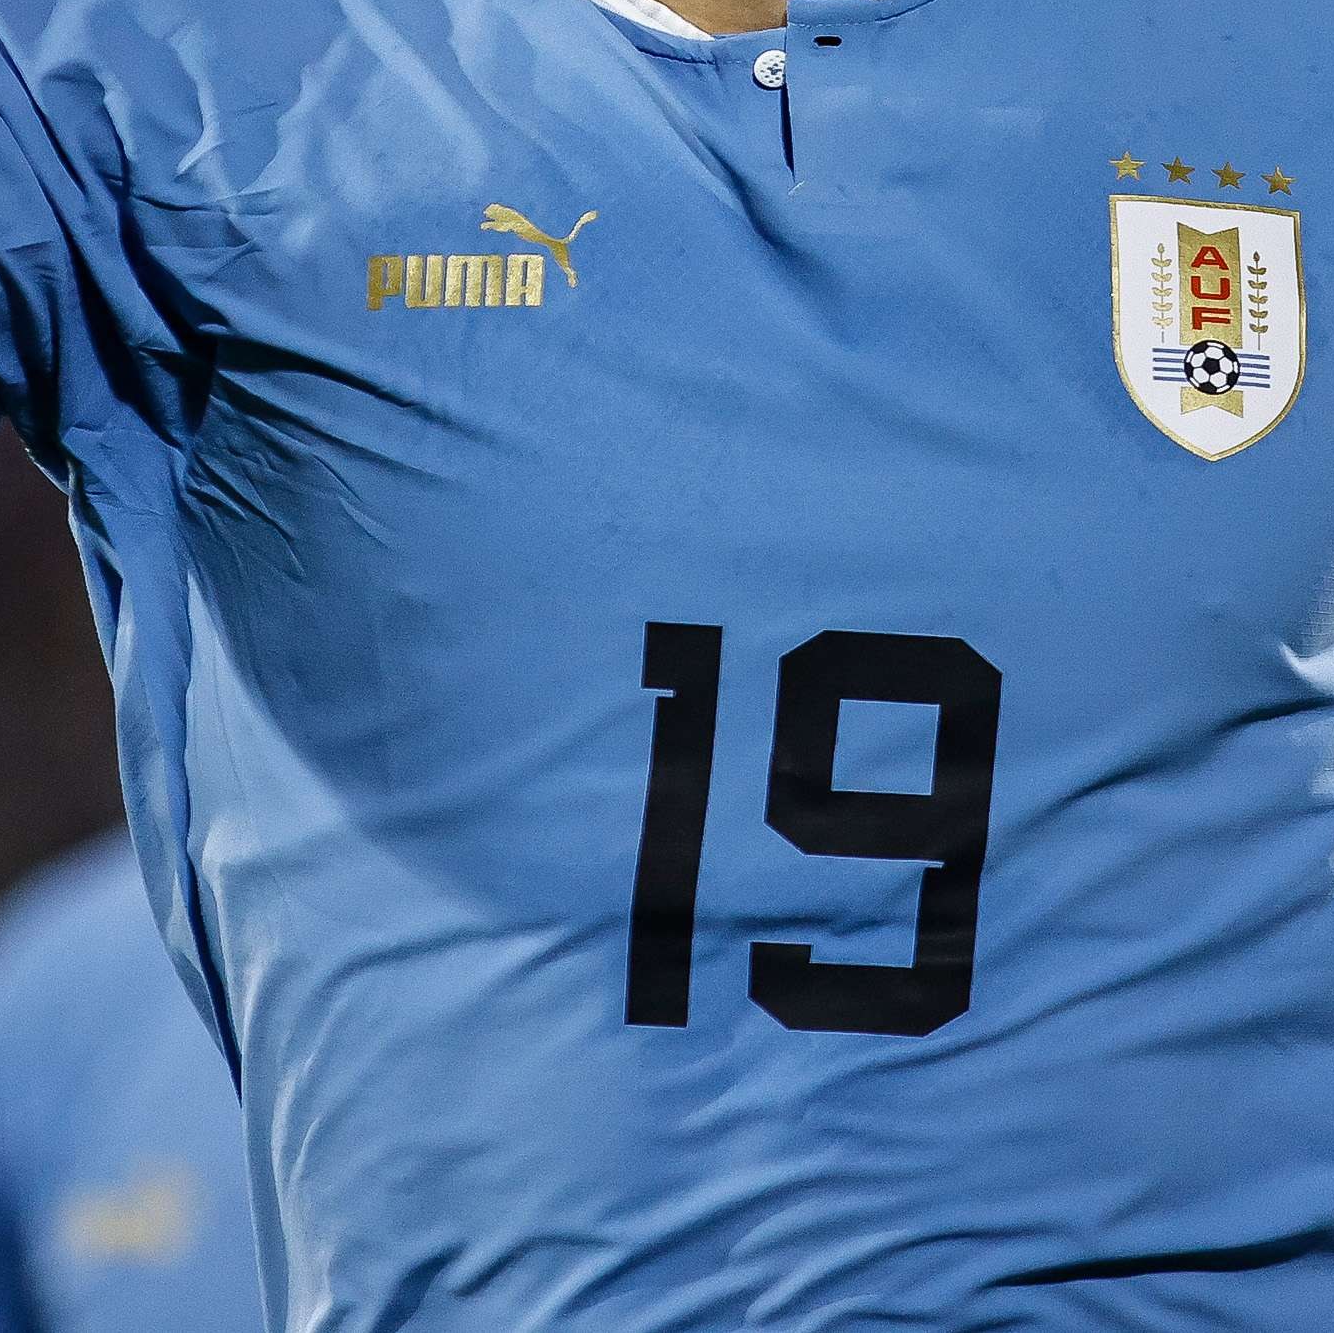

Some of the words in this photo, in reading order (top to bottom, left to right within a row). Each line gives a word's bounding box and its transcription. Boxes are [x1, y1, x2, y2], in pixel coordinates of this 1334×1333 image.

[367, 254, 545, 310] PUMA
[1190, 246, 1231, 330] AUF
[624, 621, 1003, 1038] 19
